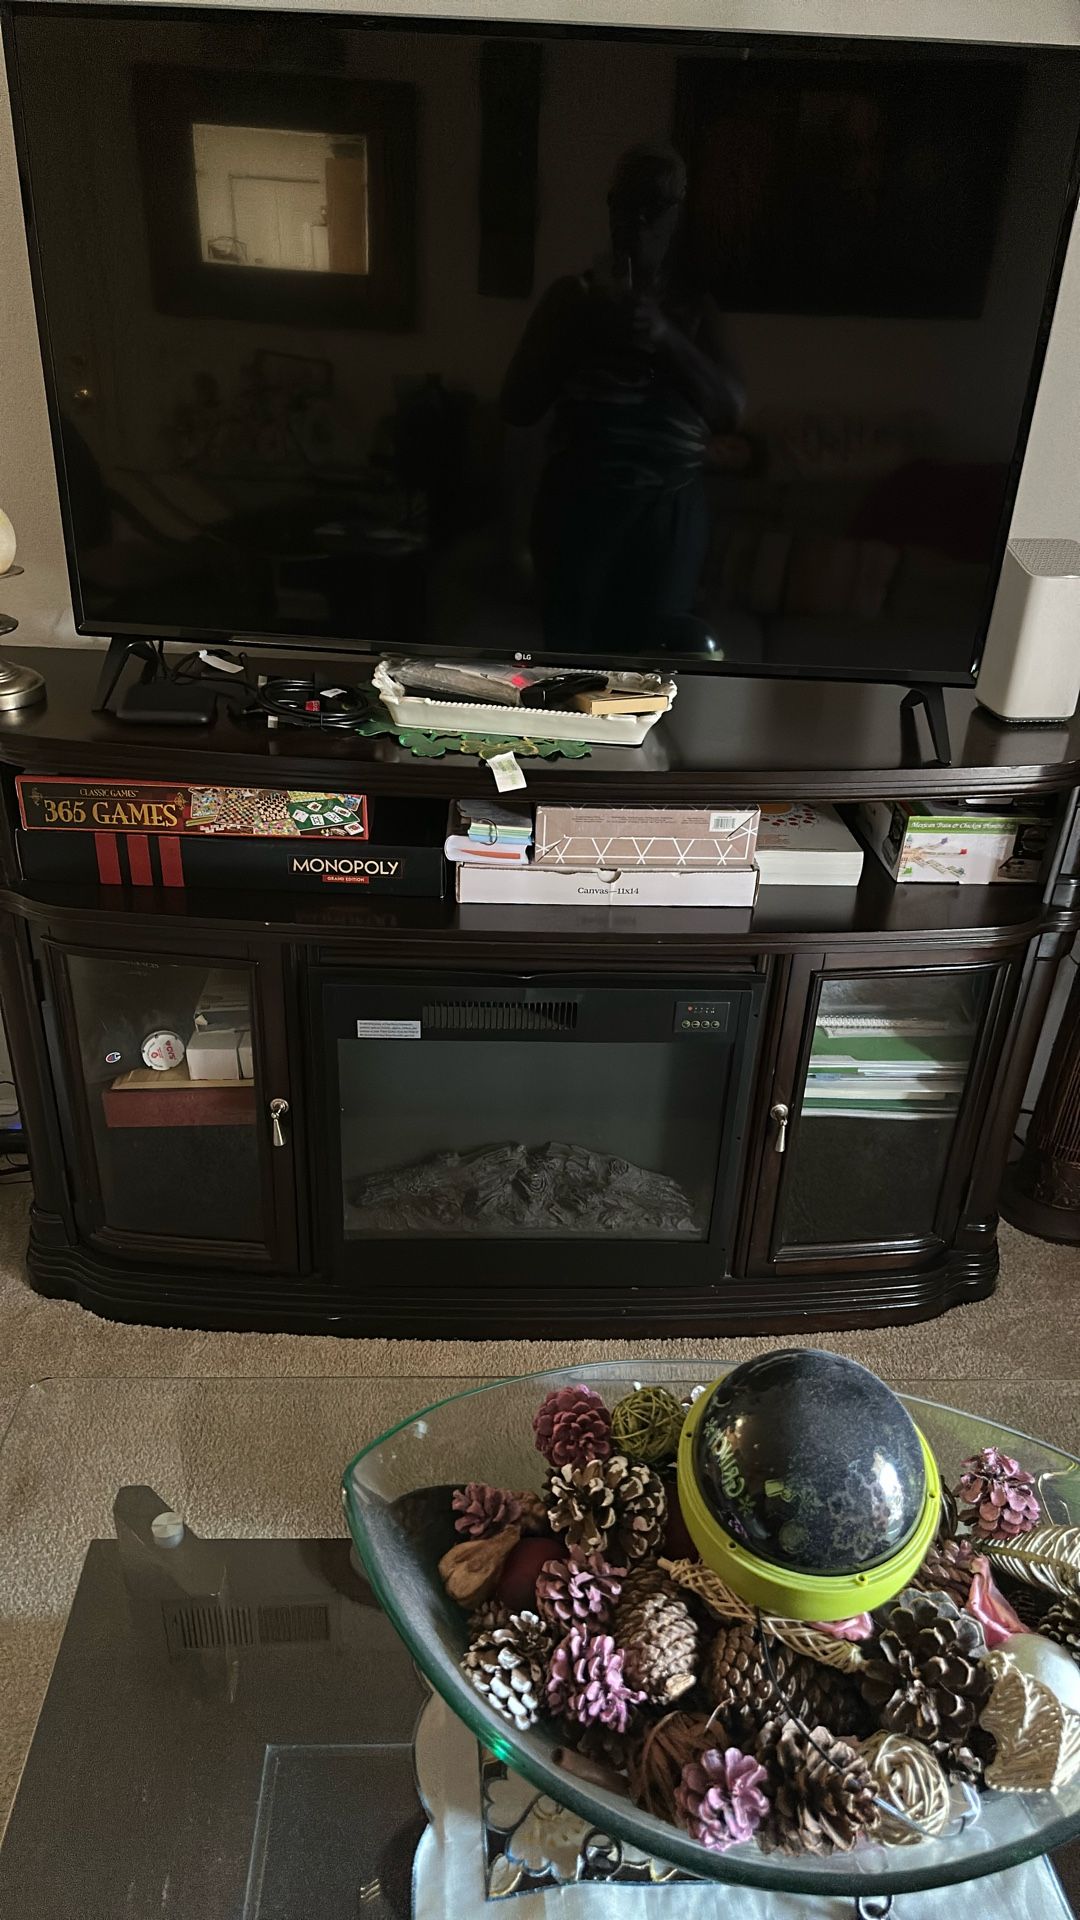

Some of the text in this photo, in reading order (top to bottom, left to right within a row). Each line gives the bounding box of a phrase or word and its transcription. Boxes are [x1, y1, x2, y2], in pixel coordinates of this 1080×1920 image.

[79, 788, 137, 798] CLASSIC GAMES
[44, 799, 178, 827] 365 GAMES
[293, 858, 399, 875] MONOPOLY
